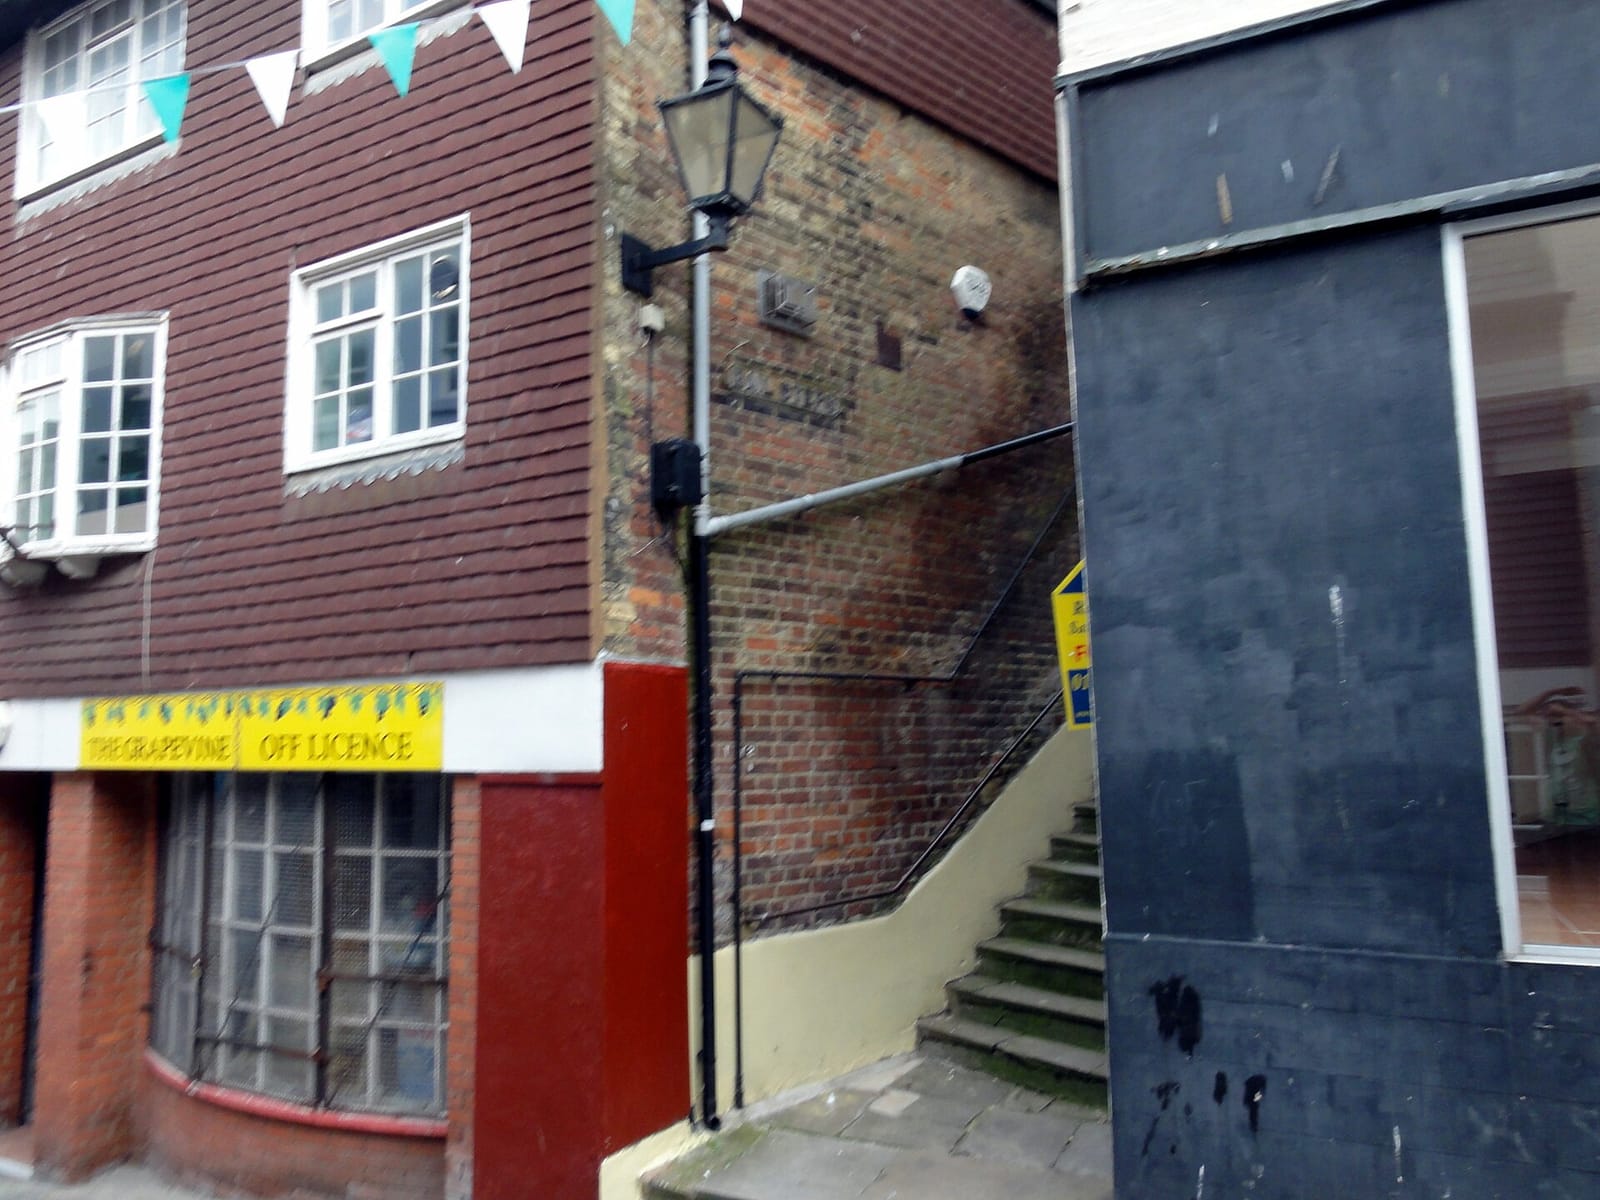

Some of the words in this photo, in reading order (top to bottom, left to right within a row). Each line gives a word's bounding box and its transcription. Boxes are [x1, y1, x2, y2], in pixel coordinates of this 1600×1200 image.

[87, 737, 123, 761] THE
[123, 736, 231, 761] GRAPEVINE
[258, 734, 302, 761] OFF
[306, 732, 413, 761] LICENCE
